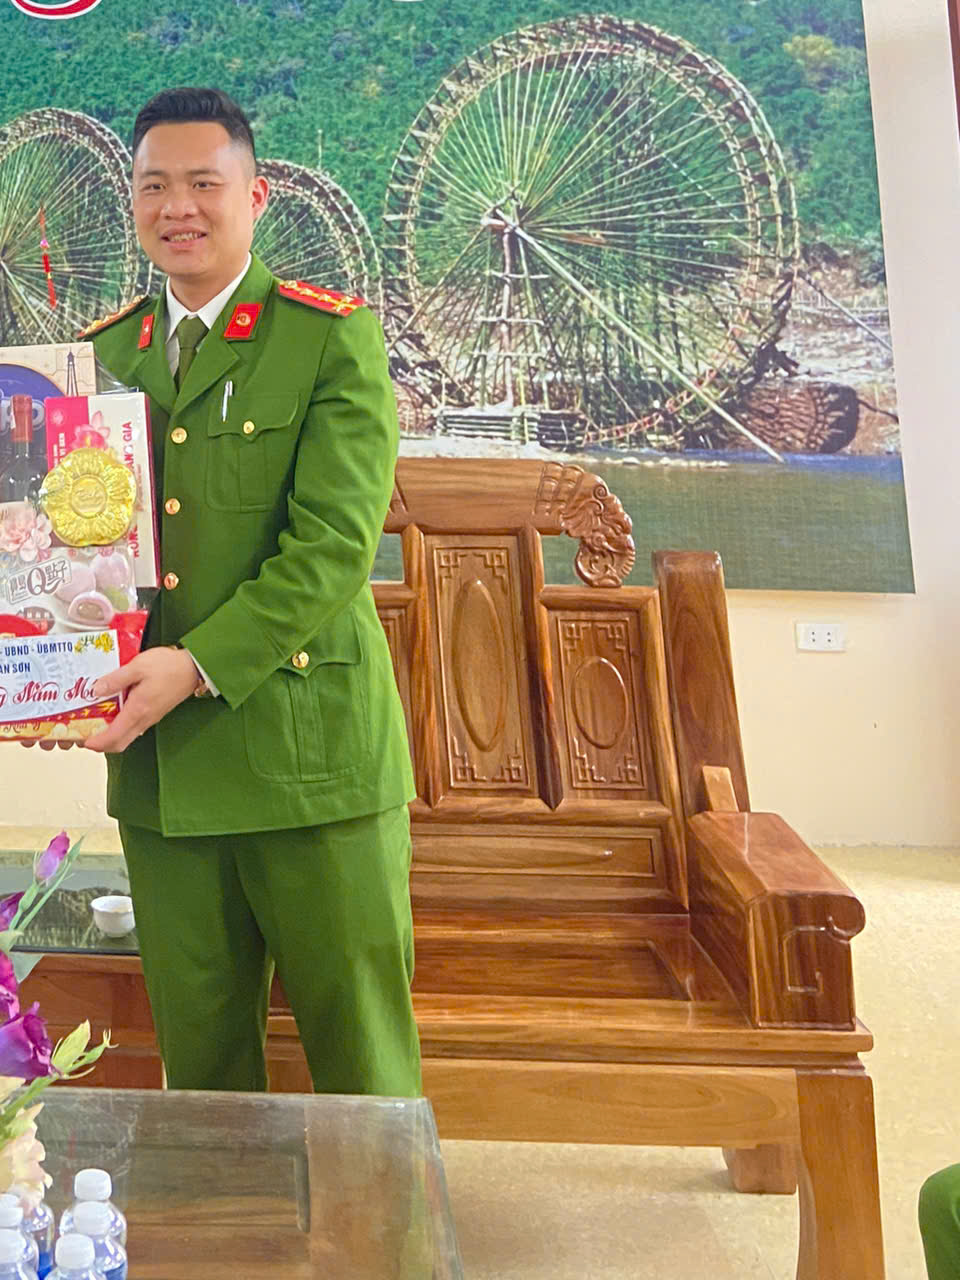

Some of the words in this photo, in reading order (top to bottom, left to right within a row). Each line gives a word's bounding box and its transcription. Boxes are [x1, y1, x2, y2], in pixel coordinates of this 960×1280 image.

[4, 644, 29, 657] UBND
[12, 661, 31, 674] SƠN
[12, 680, 60, 704] Năm
